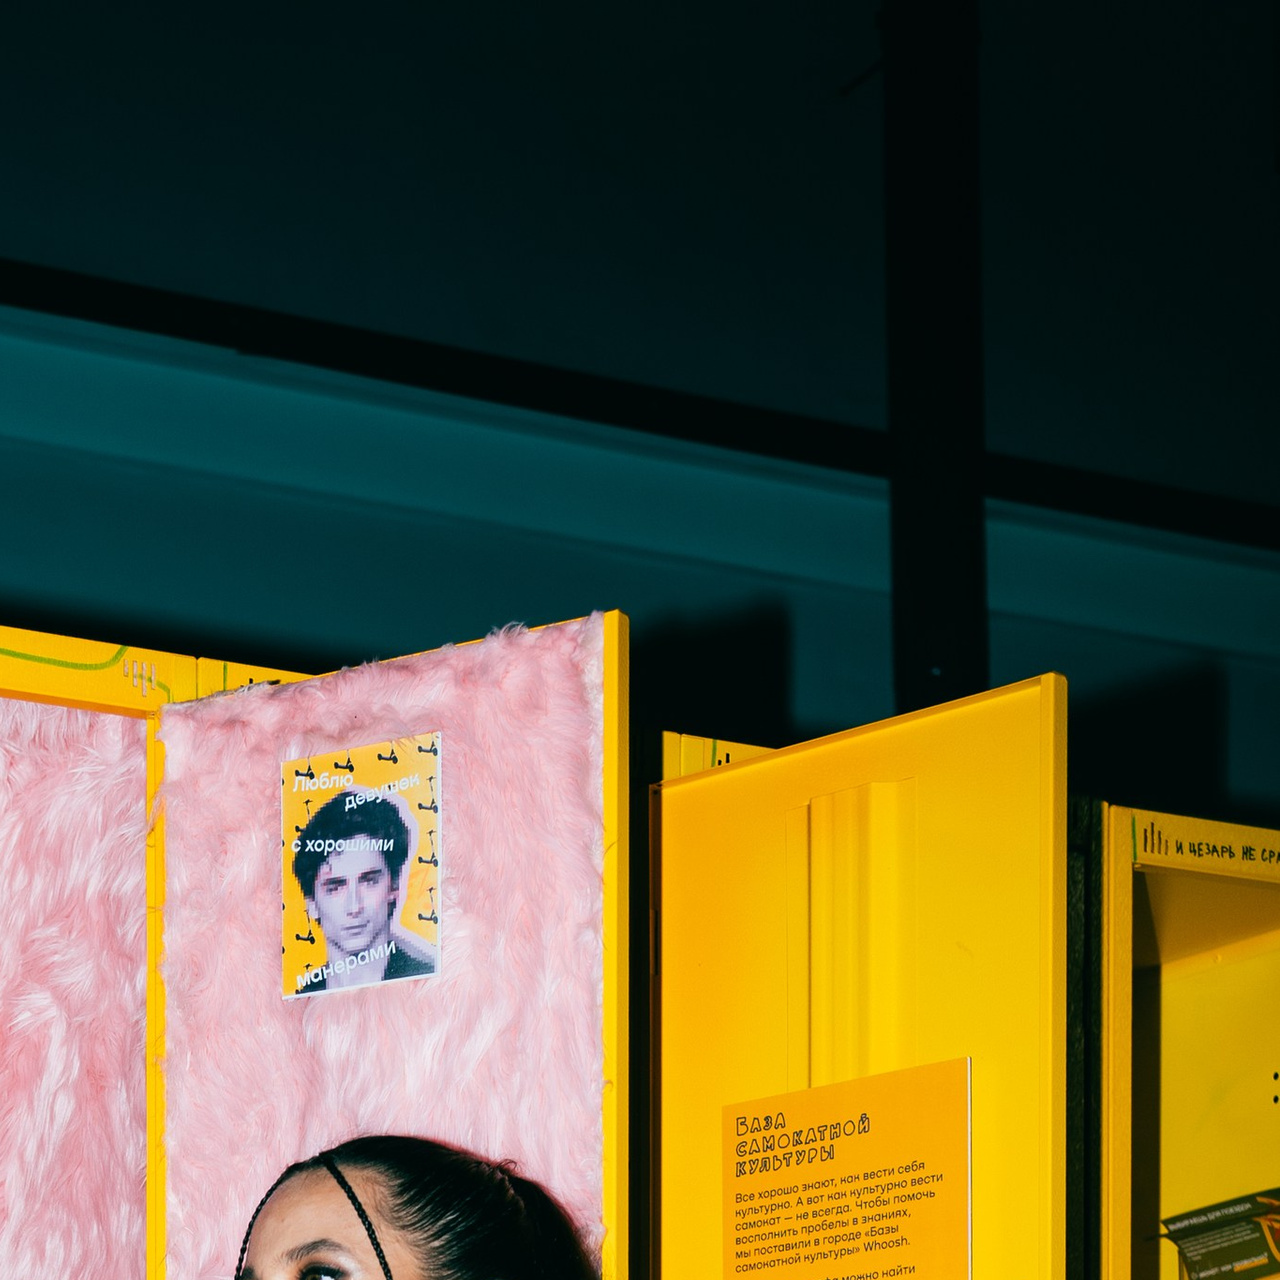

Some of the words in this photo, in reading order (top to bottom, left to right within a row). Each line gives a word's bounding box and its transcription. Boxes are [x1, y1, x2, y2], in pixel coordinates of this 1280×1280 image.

[293, 773, 354, 792] Люблю
[344, 773, 420, 811] девушек
[291, 839, 301, 852] с
[305, 838, 394, 856] хорошими
[1189, 841, 1235, 860] ЦЕЗАРЬ
[1242, 845, 1256, 861] НЕ
[296, 940, 397, 988] манерами
[736, 1193, 756, 1204] Все
[758, 1185, 800, 1201] хорошо
[840, 1174, 861, 1186] как
[863, 1168, 895, 1182] вести
[897, 1161, 926, 1180] себя
[796, 1196, 805, 1208] А
[807, 1194, 826, 1206] вот
[827, 1190, 848, 1202] как
[850, 1180, 908, 1200] культурно
[911, 1174, 944, 1188] вести
[735, 1216, 782, 1232] самокат
[796, 1212, 810, 1222] не
[855, 1196, 891, 1211] Чтобы
[893, 1190, 936, 1205] помочь
[736, 1228, 799, 1246] восполнить
[801, 1219, 850, 1237] пробелы
[852, 1217, 859, 1227] в
[736, 1249, 752, 1260] мы
[754, 1240, 812, 1257] поставили
[814, 1238, 821, 1247] в
[823, 1231, 862, 1247] городе
[735, 1253, 802, 1274] самокатной
[882, 1265, 916, 1279] найти
